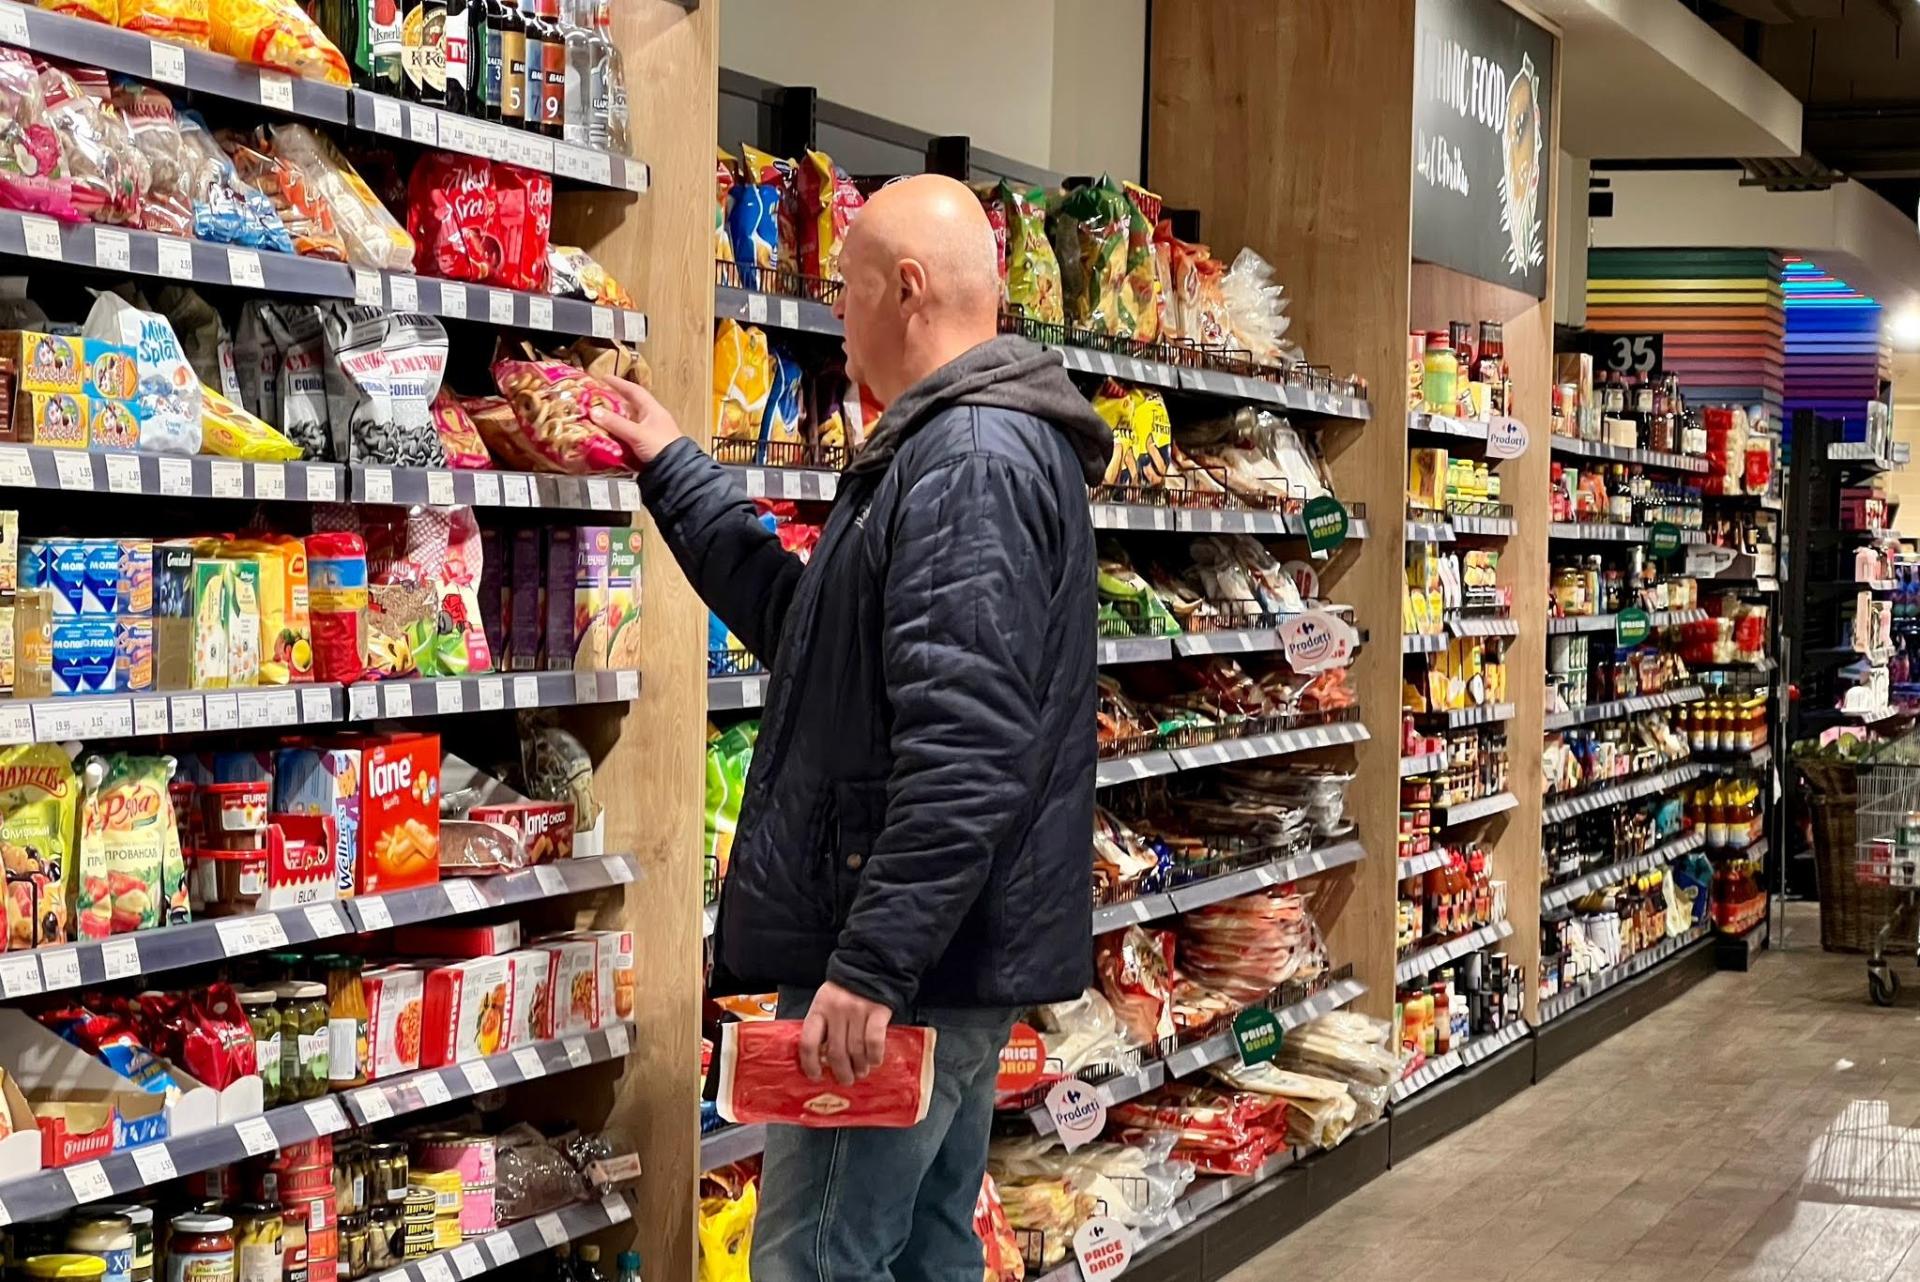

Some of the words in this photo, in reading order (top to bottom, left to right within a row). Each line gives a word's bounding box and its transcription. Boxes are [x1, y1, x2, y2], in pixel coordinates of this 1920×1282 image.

[509, 87, 521, 109] 5
[1471, 55, 1506, 134] FOOD
[545, 96, 558, 118] 9
[1608, 336, 1656, 372] 35
[1490, 433, 1526, 447] Prodotti
[1309, 512, 1342, 529] PRICE
[1312, 522, 1343, 539] DROP
[1288, 630, 1332, 655] Prodotti
[338, 804, 353, 890] Wellness
[297, 888, 318, 904] BLOK
[1240, 1022, 1275, 1044] PRICE
[1245, 1033, 1276, 1052] DROP
[1055, 1098, 1100, 1125] Prodotti
[1083, 1239, 1123, 1263] PRICE
[1088, 1252, 1124, 1275] DROP
